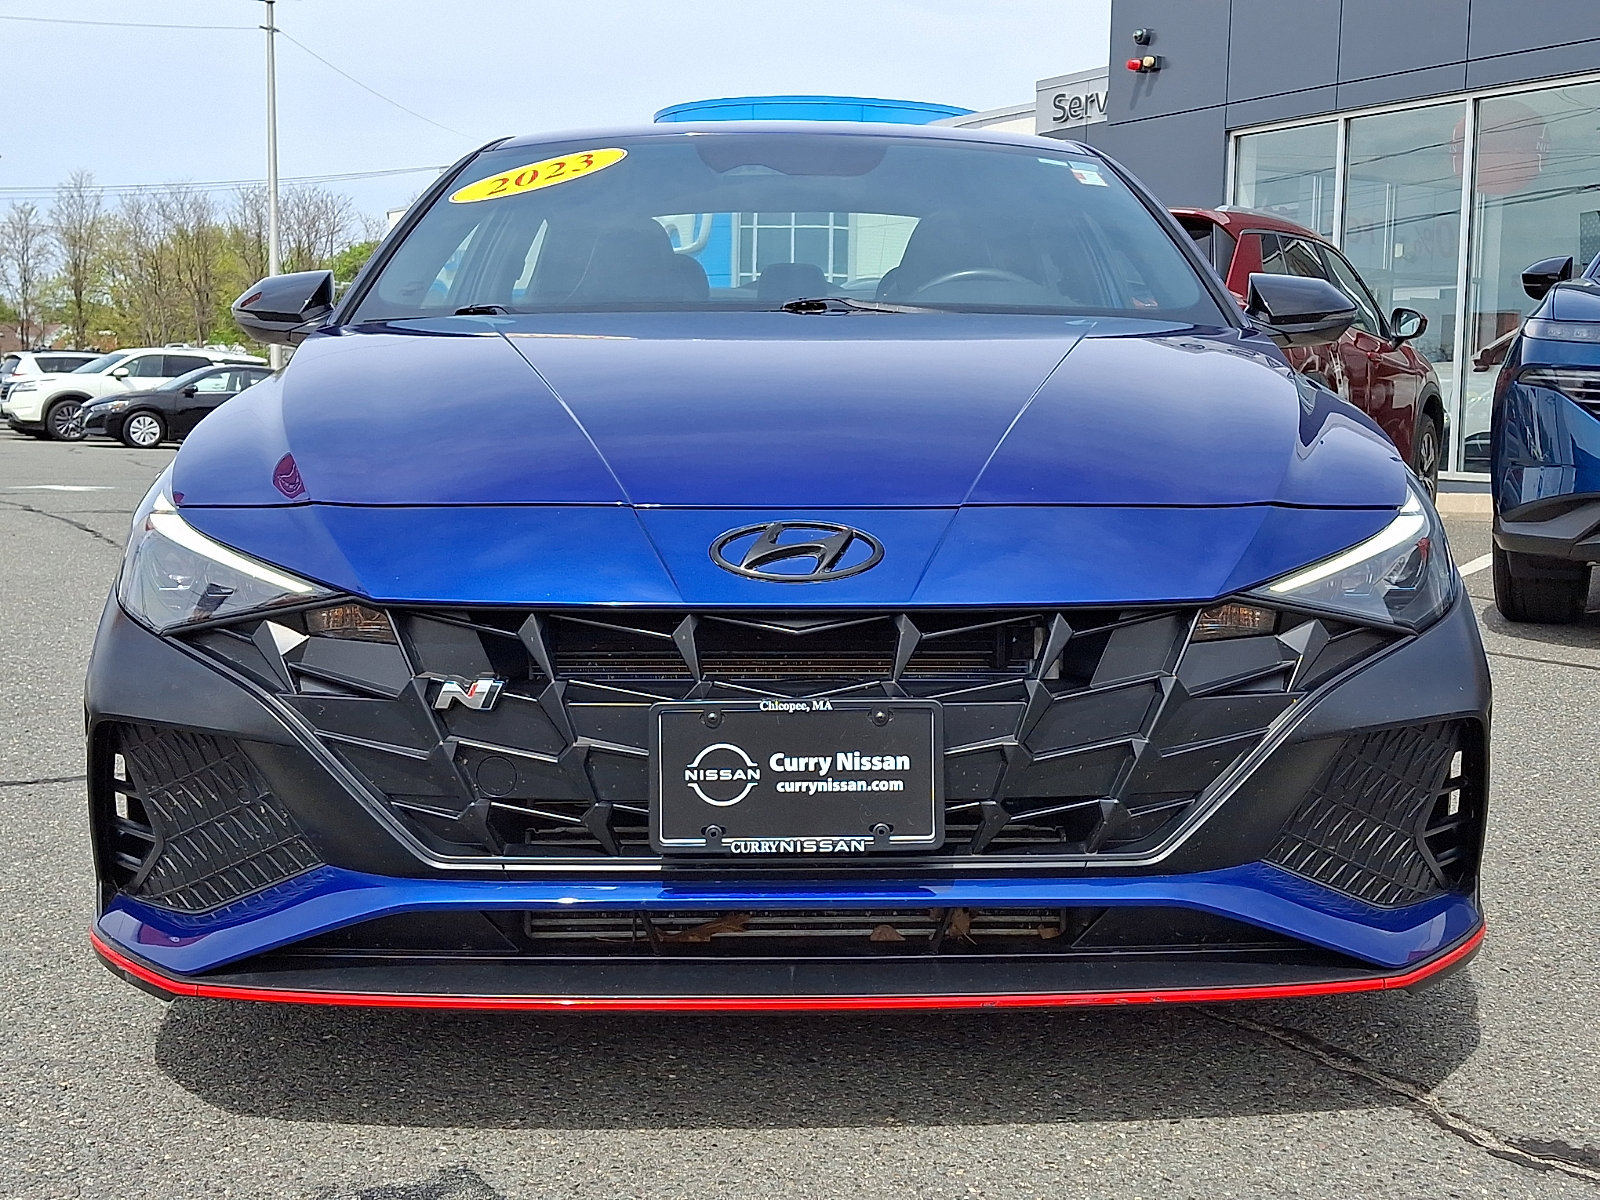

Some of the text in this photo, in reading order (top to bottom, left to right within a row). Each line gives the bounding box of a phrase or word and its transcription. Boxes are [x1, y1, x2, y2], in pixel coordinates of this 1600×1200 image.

[486, 154, 594, 196] 2023
[760, 699, 834, 712] Chicopee, MA
[769, 751, 910, 776] Curry Nissan
[684, 769, 761, 781] NISSAN
[776, 777, 904, 795] currynissan.com
